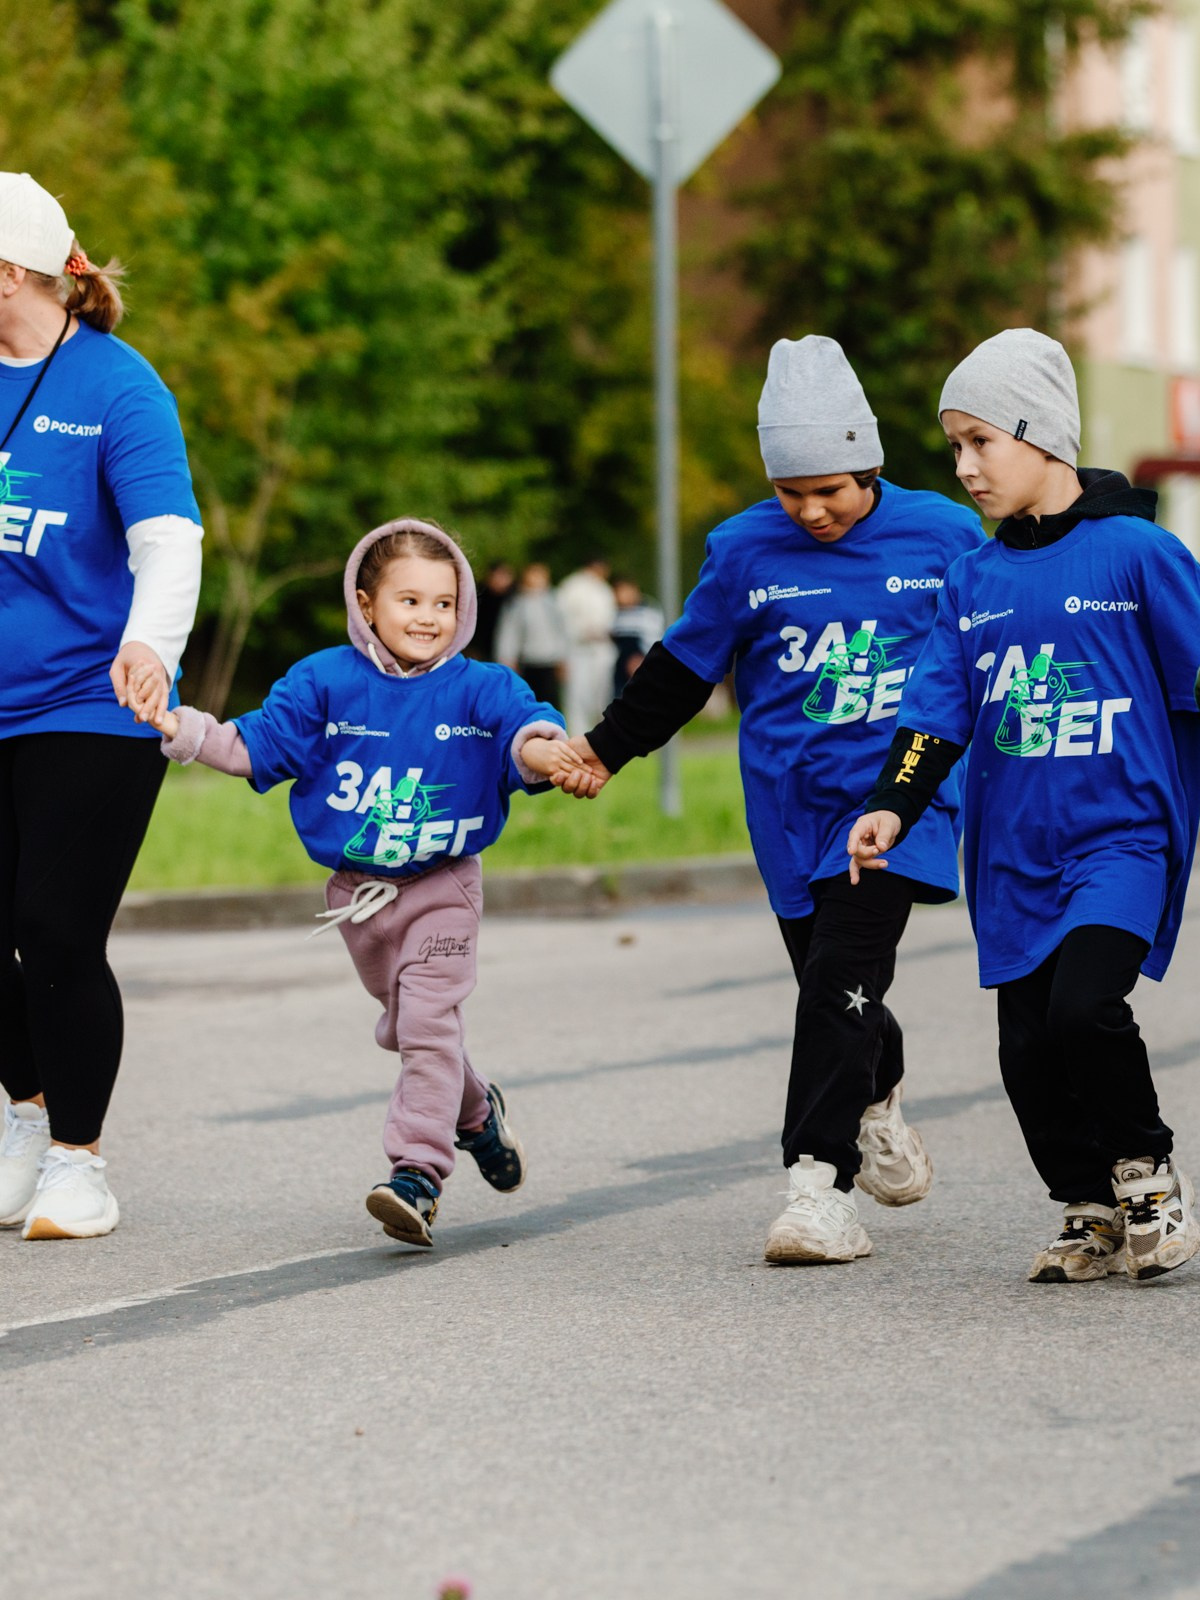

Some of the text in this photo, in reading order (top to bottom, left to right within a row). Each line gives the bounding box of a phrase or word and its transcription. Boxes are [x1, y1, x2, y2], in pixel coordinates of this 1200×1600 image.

[0, 504, 68, 557] ЕГ
[1083, 600, 1139, 612] РОСАТОМ
[778, 620, 877, 673] ЗА!
[827, 666, 915, 725] БЕ
[1020, 698, 1132, 758] БЕГ
[326, 760, 424, 819] ЗА!
[373, 816, 484, 868] БЕГ
